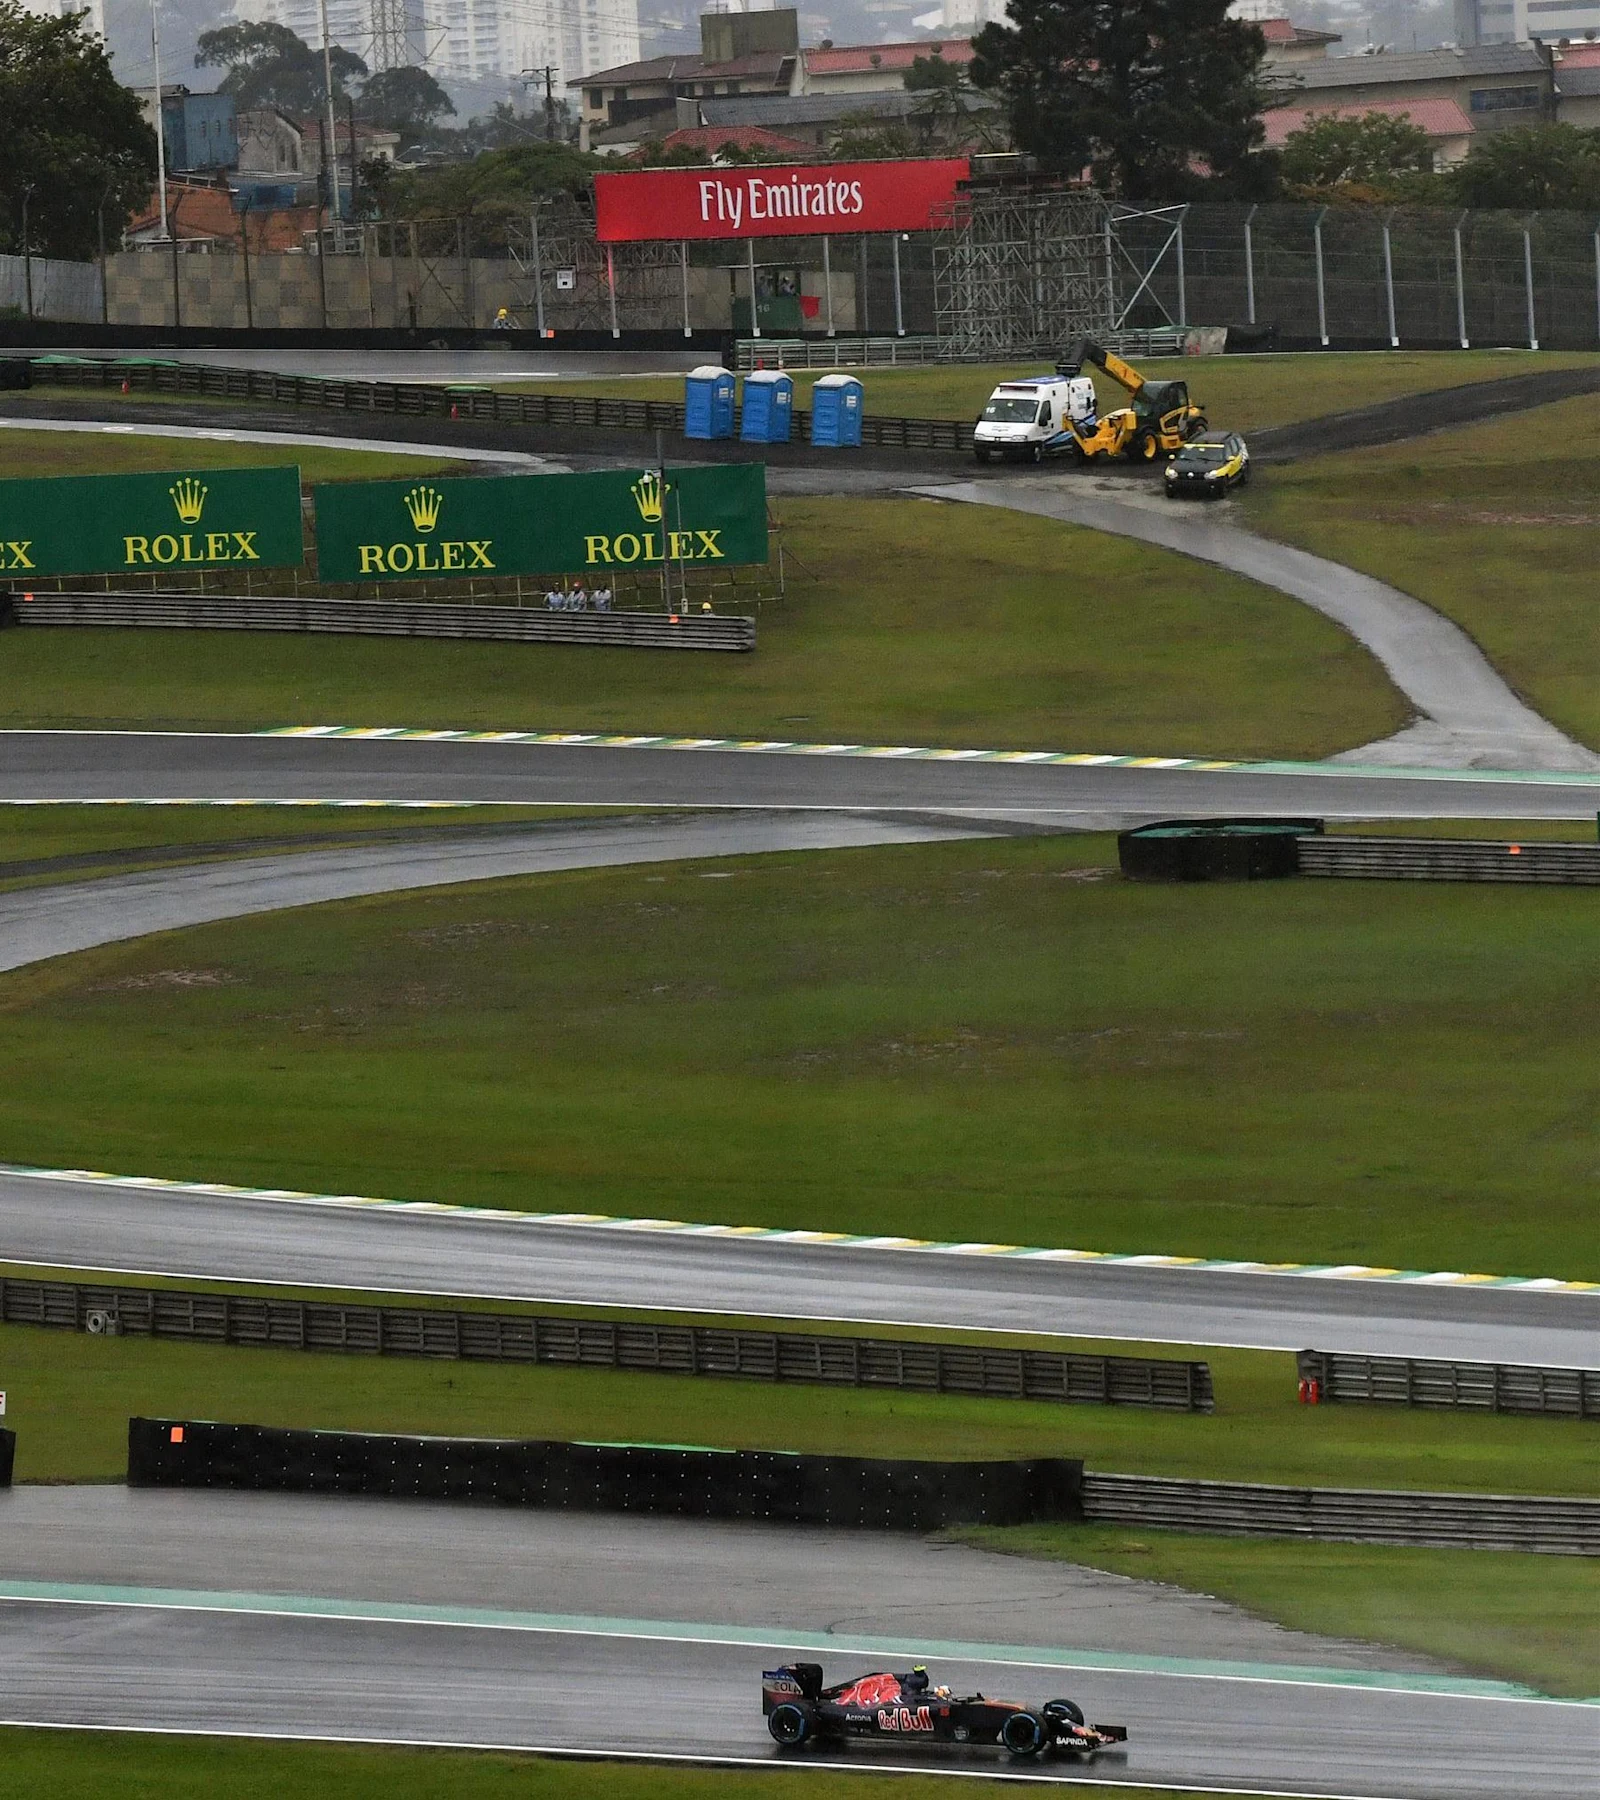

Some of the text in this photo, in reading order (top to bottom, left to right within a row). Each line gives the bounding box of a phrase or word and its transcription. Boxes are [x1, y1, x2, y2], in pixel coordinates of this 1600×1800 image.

[699, 173, 864, 229] Fly Emirates
[123, 531, 261, 565] ROLEX
[358, 540, 496, 574] ROLEX
[583, 529, 725, 565] ROLEX
[878, 1706, 935, 1731] Red Bull
[1056, 1736, 1088, 1747] SAPINDA
